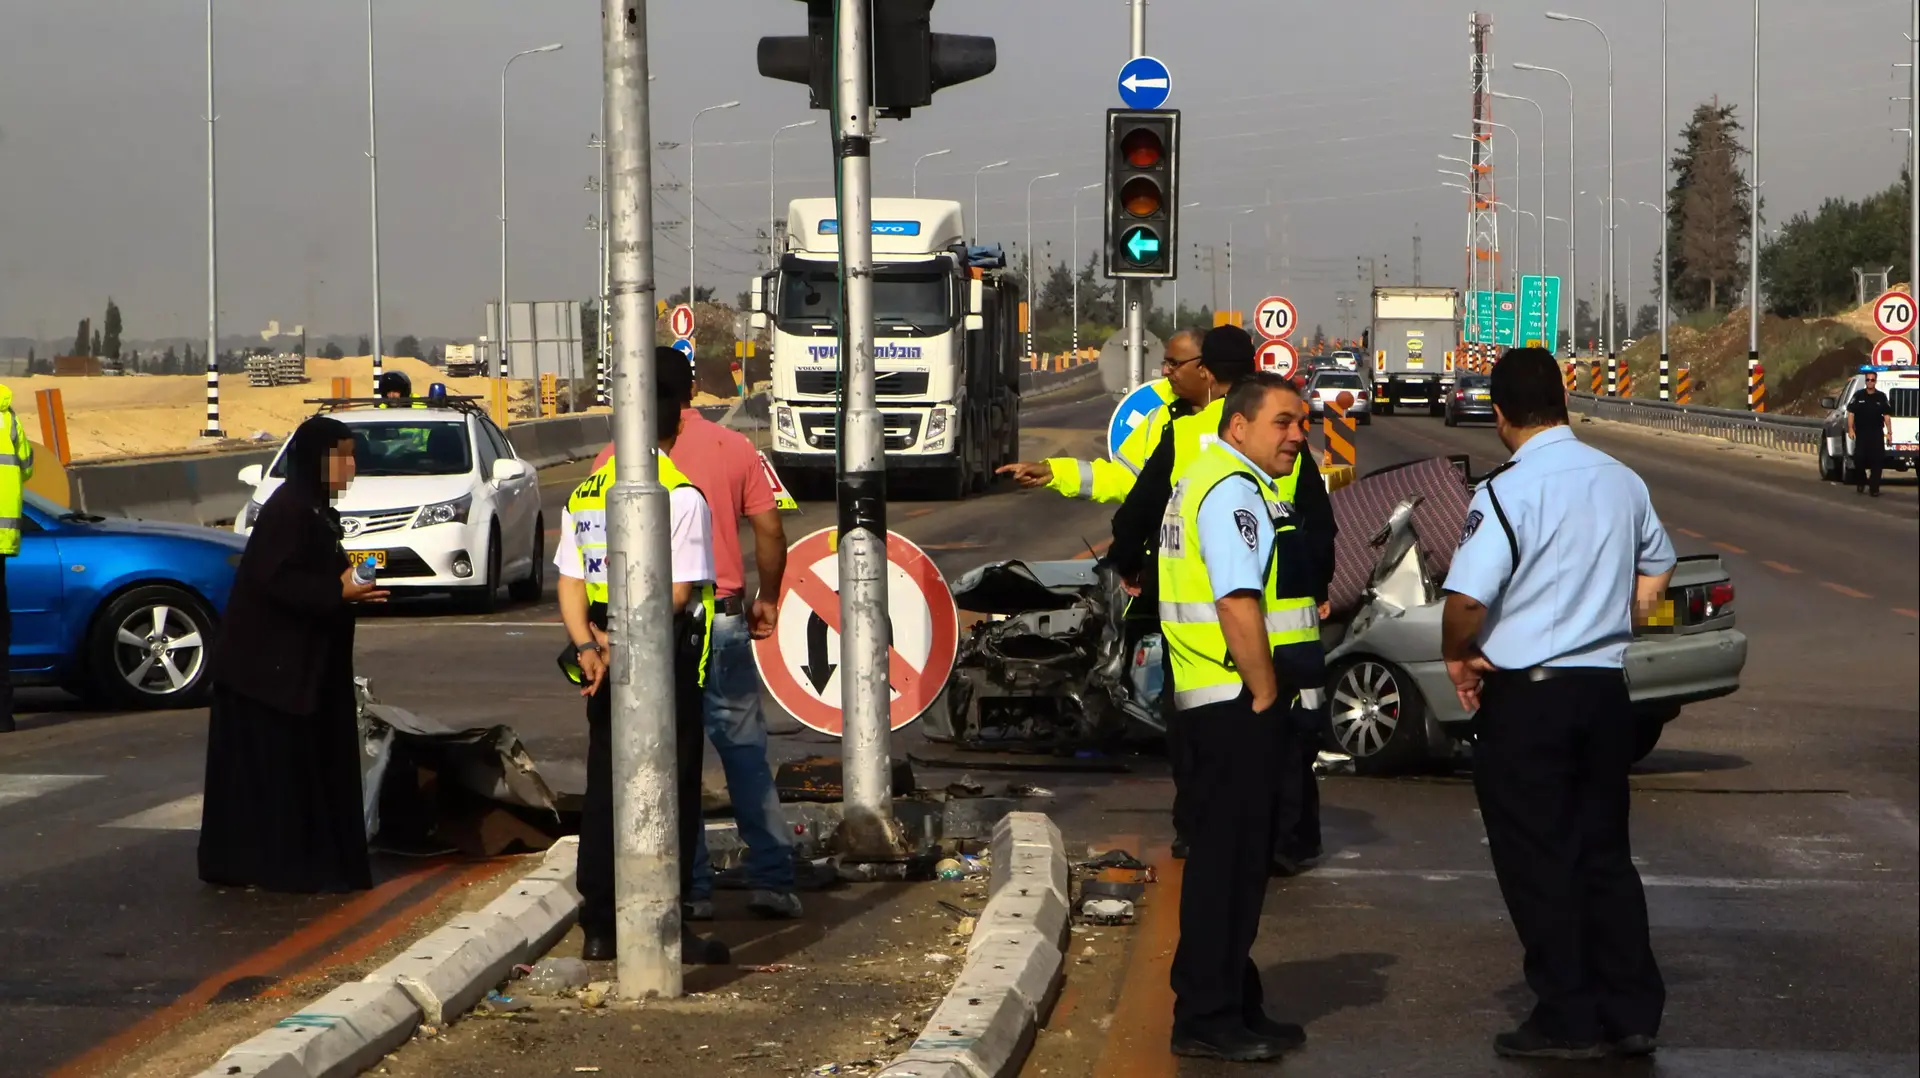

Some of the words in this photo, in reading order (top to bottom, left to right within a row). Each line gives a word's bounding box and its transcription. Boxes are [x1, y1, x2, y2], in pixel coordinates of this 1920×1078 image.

[1262, 309, 1288, 328] 70
[1883, 304, 1910, 323] 70
[873, 342, 921, 359] הובלות
